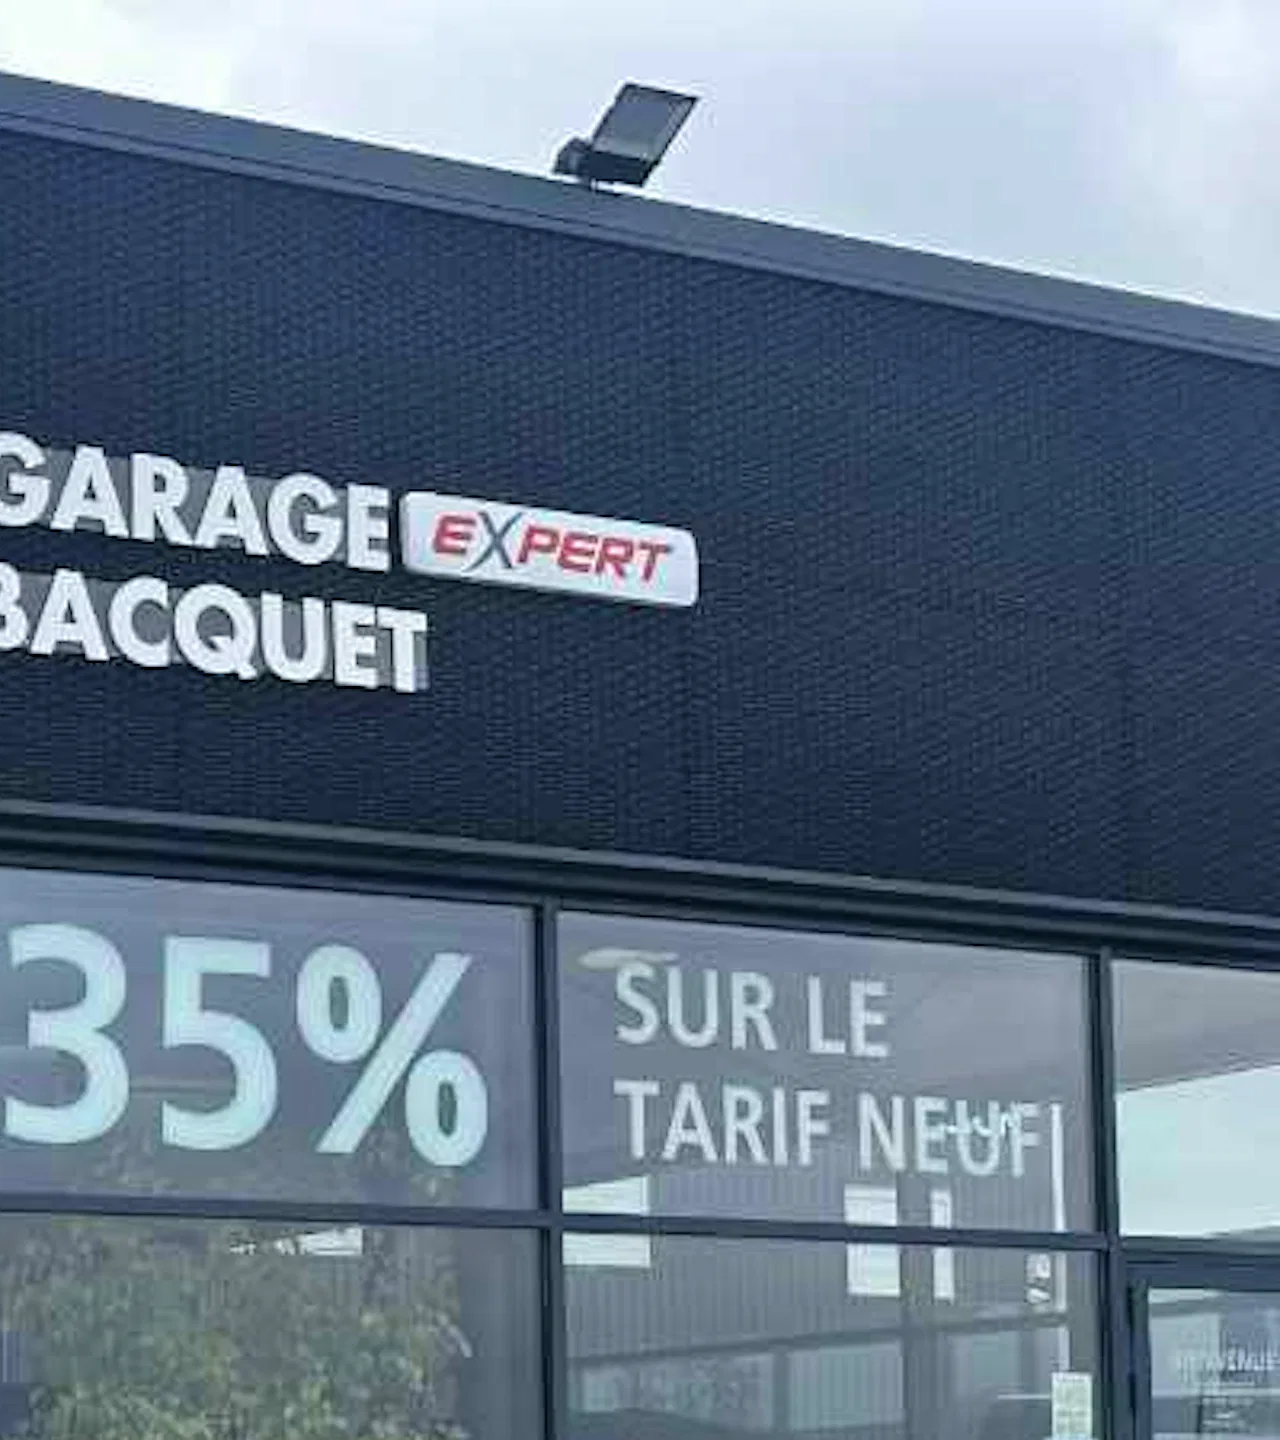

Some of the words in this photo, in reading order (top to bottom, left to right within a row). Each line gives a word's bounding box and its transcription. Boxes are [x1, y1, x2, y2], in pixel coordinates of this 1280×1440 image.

[430, 508, 675, 586] EXPERT
[614, 960, 779, 1052] SUR
[806, 975, 891, 1058] LE
[613, 1079, 831, 1167] TARIF
[857, 1091, 1040, 1179] NEUF
